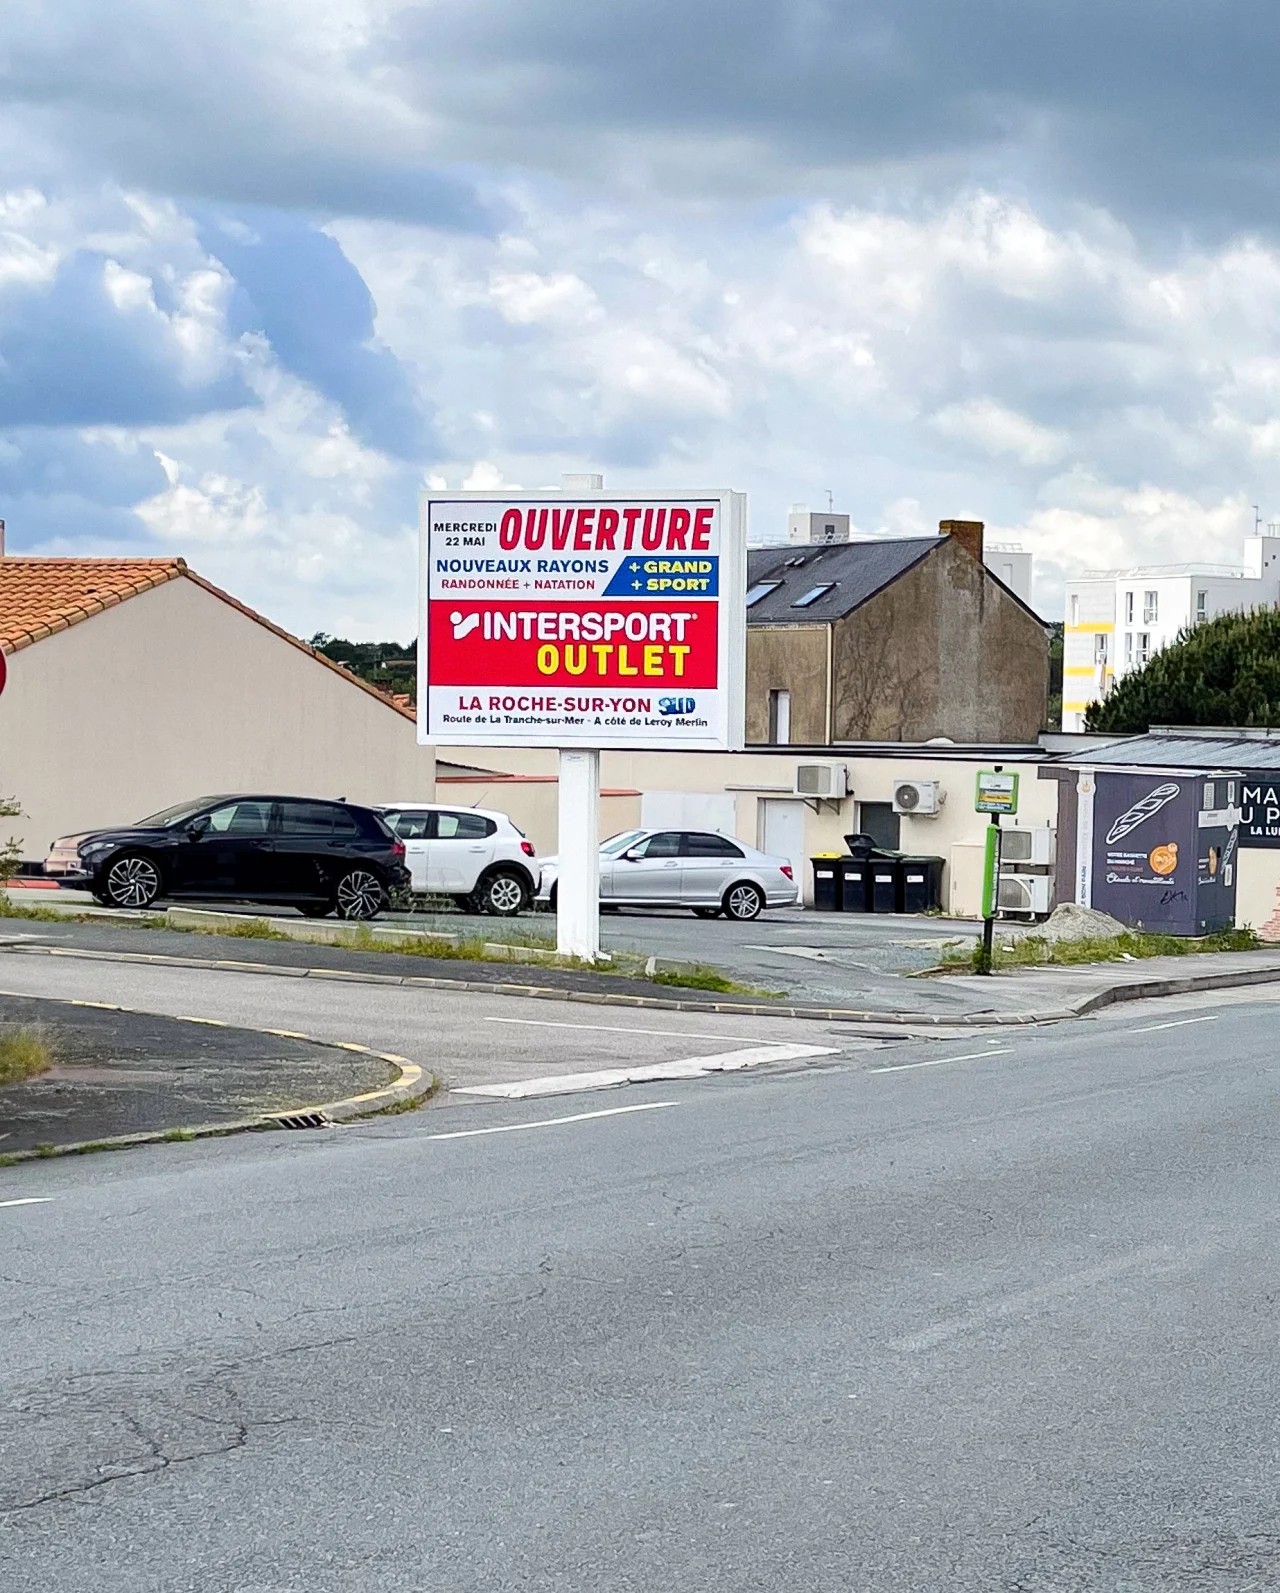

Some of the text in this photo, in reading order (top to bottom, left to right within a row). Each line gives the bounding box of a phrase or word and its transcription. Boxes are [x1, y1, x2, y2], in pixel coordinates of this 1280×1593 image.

[434, 523, 497, 532] MERCREDI
[499, 508, 714, 551] OUVERTURE
[445, 537, 485, 546] 22 MAI
[436, 559, 609, 573] NOUVEAUX RAYONS
[643, 561, 712, 573] GRAND
[441, 578, 519, 590] RANDONNÉE
[534, 580, 595, 590] NATATION
[646, 578, 710, 591] SPORT
[483, 611, 692, 642] INTERSPORT
[536, 644, 691, 676] OUTLET
[458, 696, 696, 716] LA ROCHE-SUR-YON SUD
[443, 714, 472, 723] Route
[475, 714, 487, 724] de
[490, 715, 501, 724] La
[504, 715, 584, 725] Tranche-sur-Mer
[629, 717, 641, 726] de
[644, 717, 672, 727] Leroy
[675, 717, 708, 727] Merlin
[1250, 826, 1262, 835] LA
